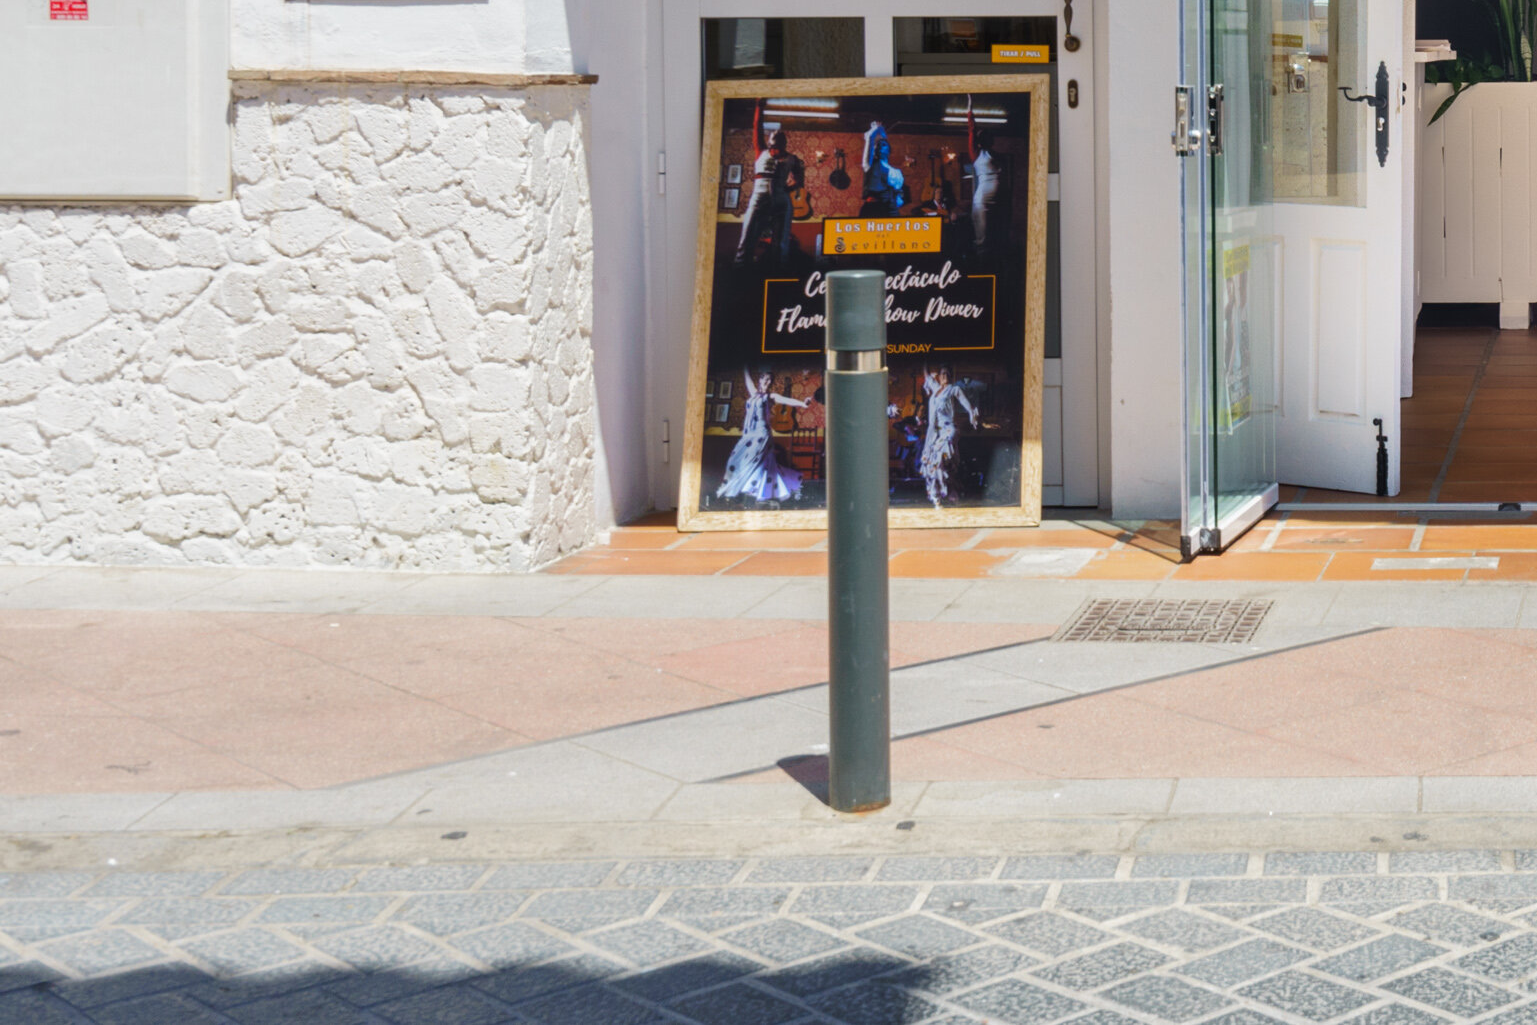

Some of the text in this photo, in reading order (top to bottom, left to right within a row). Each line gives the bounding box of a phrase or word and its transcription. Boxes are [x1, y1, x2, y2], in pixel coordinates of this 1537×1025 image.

[835, 220, 930, 233] Los Huertos
[834, 237, 931, 253] Sevillano
[884, 293, 921, 324] how
[924, 296, 984, 324] Dinner
[886, 343, 932, 354] SUNDAY
